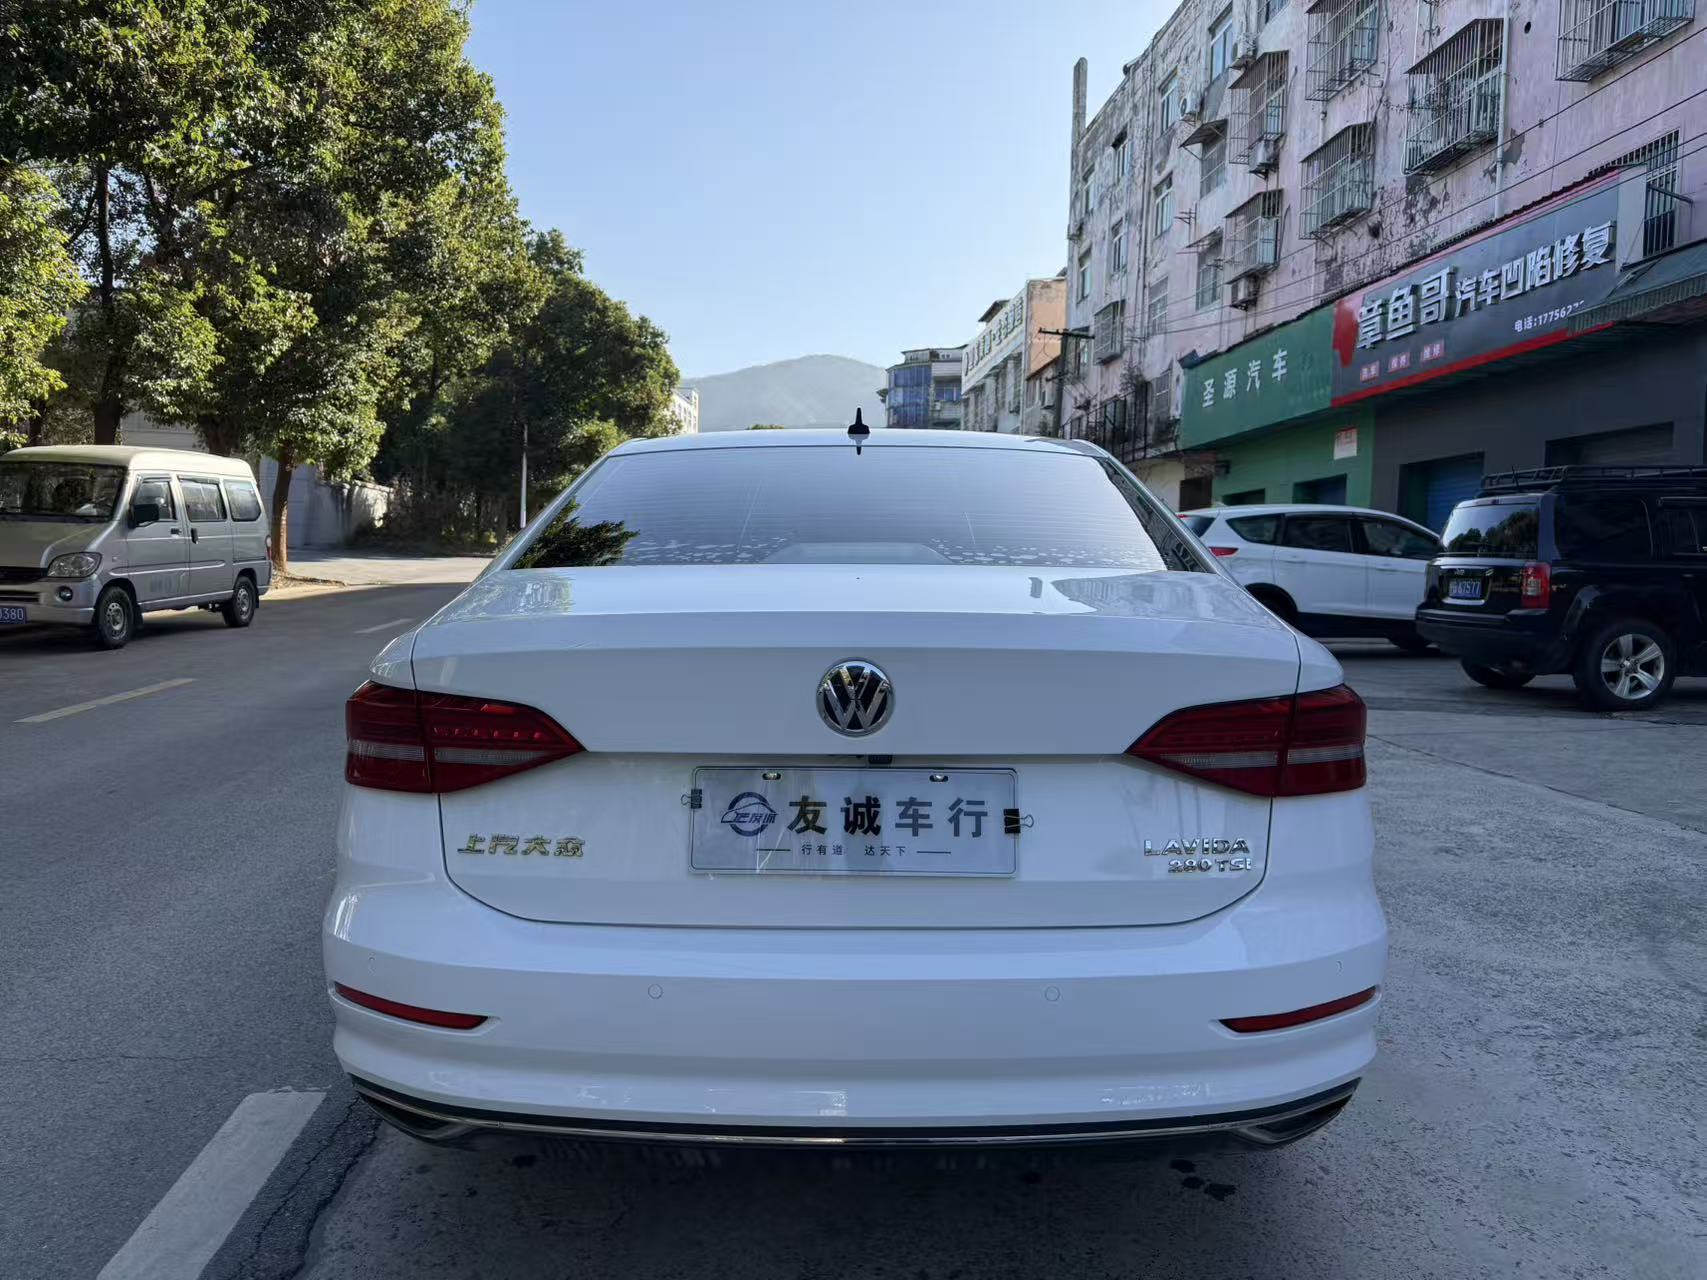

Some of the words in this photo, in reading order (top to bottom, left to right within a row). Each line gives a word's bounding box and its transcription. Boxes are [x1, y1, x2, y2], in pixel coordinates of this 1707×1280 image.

[1356, 265, 1456, 349] 章鱼哥
[1455, 220, 1616, 317] 汽车凹陷修复
[1202, 348, 1288, 408] 圣源汽车
[0, 607, 24, 620] 380
[787, 795, 989, 839] 友诚车行
[801, 843, 844, 857] 行有道
[864, 844, 907, 857] 达天下
[1143, 838, 1251, 856] LAVIDA
